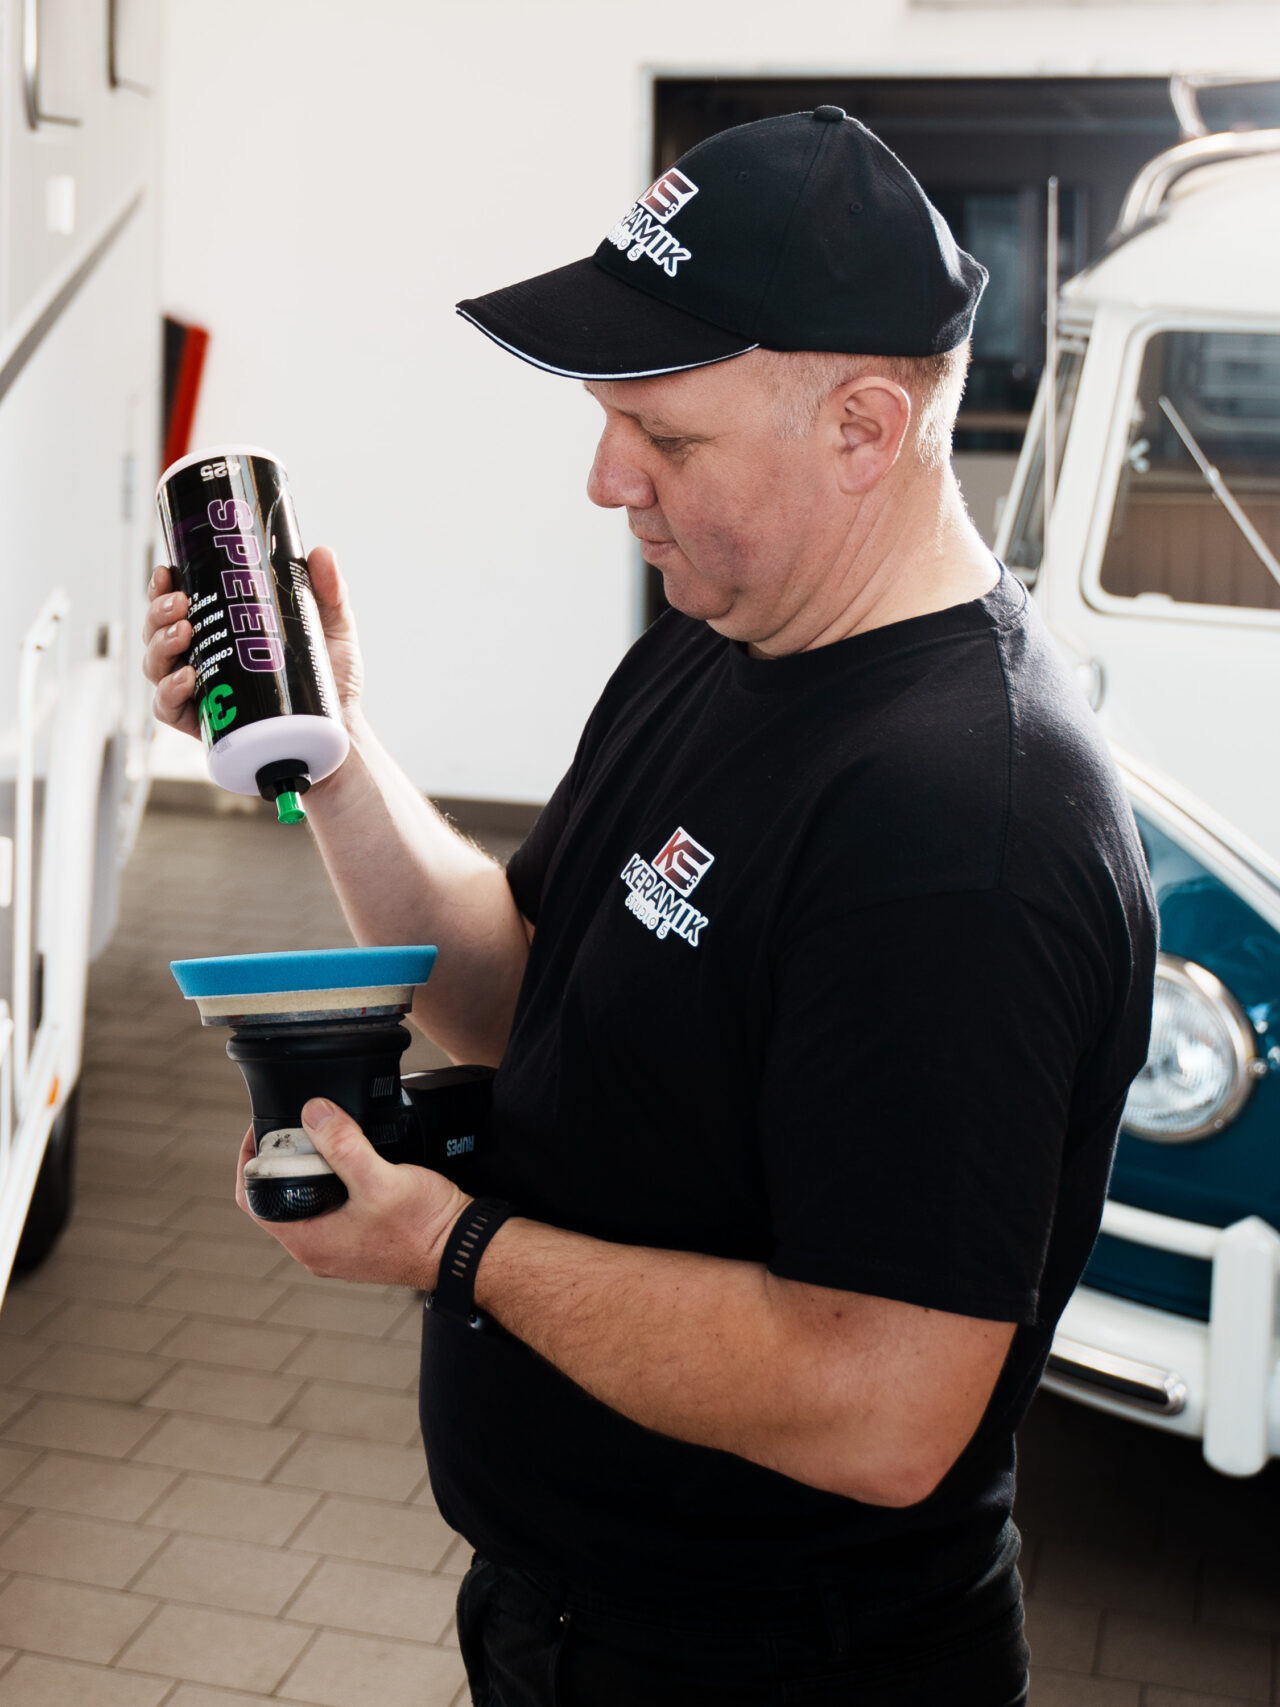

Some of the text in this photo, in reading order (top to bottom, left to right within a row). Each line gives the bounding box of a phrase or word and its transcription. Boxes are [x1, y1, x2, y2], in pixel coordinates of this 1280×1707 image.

[207, 498, 286, 673] SPEED
[203, 609, 224, 627] HIGH
[199, 628, 228, 651] POLISH
[202, 663, 220, 683] TRUE
[621, 853, 708, 946] KERAMIK
[625, 891, 671, 939] STUDIO 5
[446, 1135, 475, 1157] RUPES
